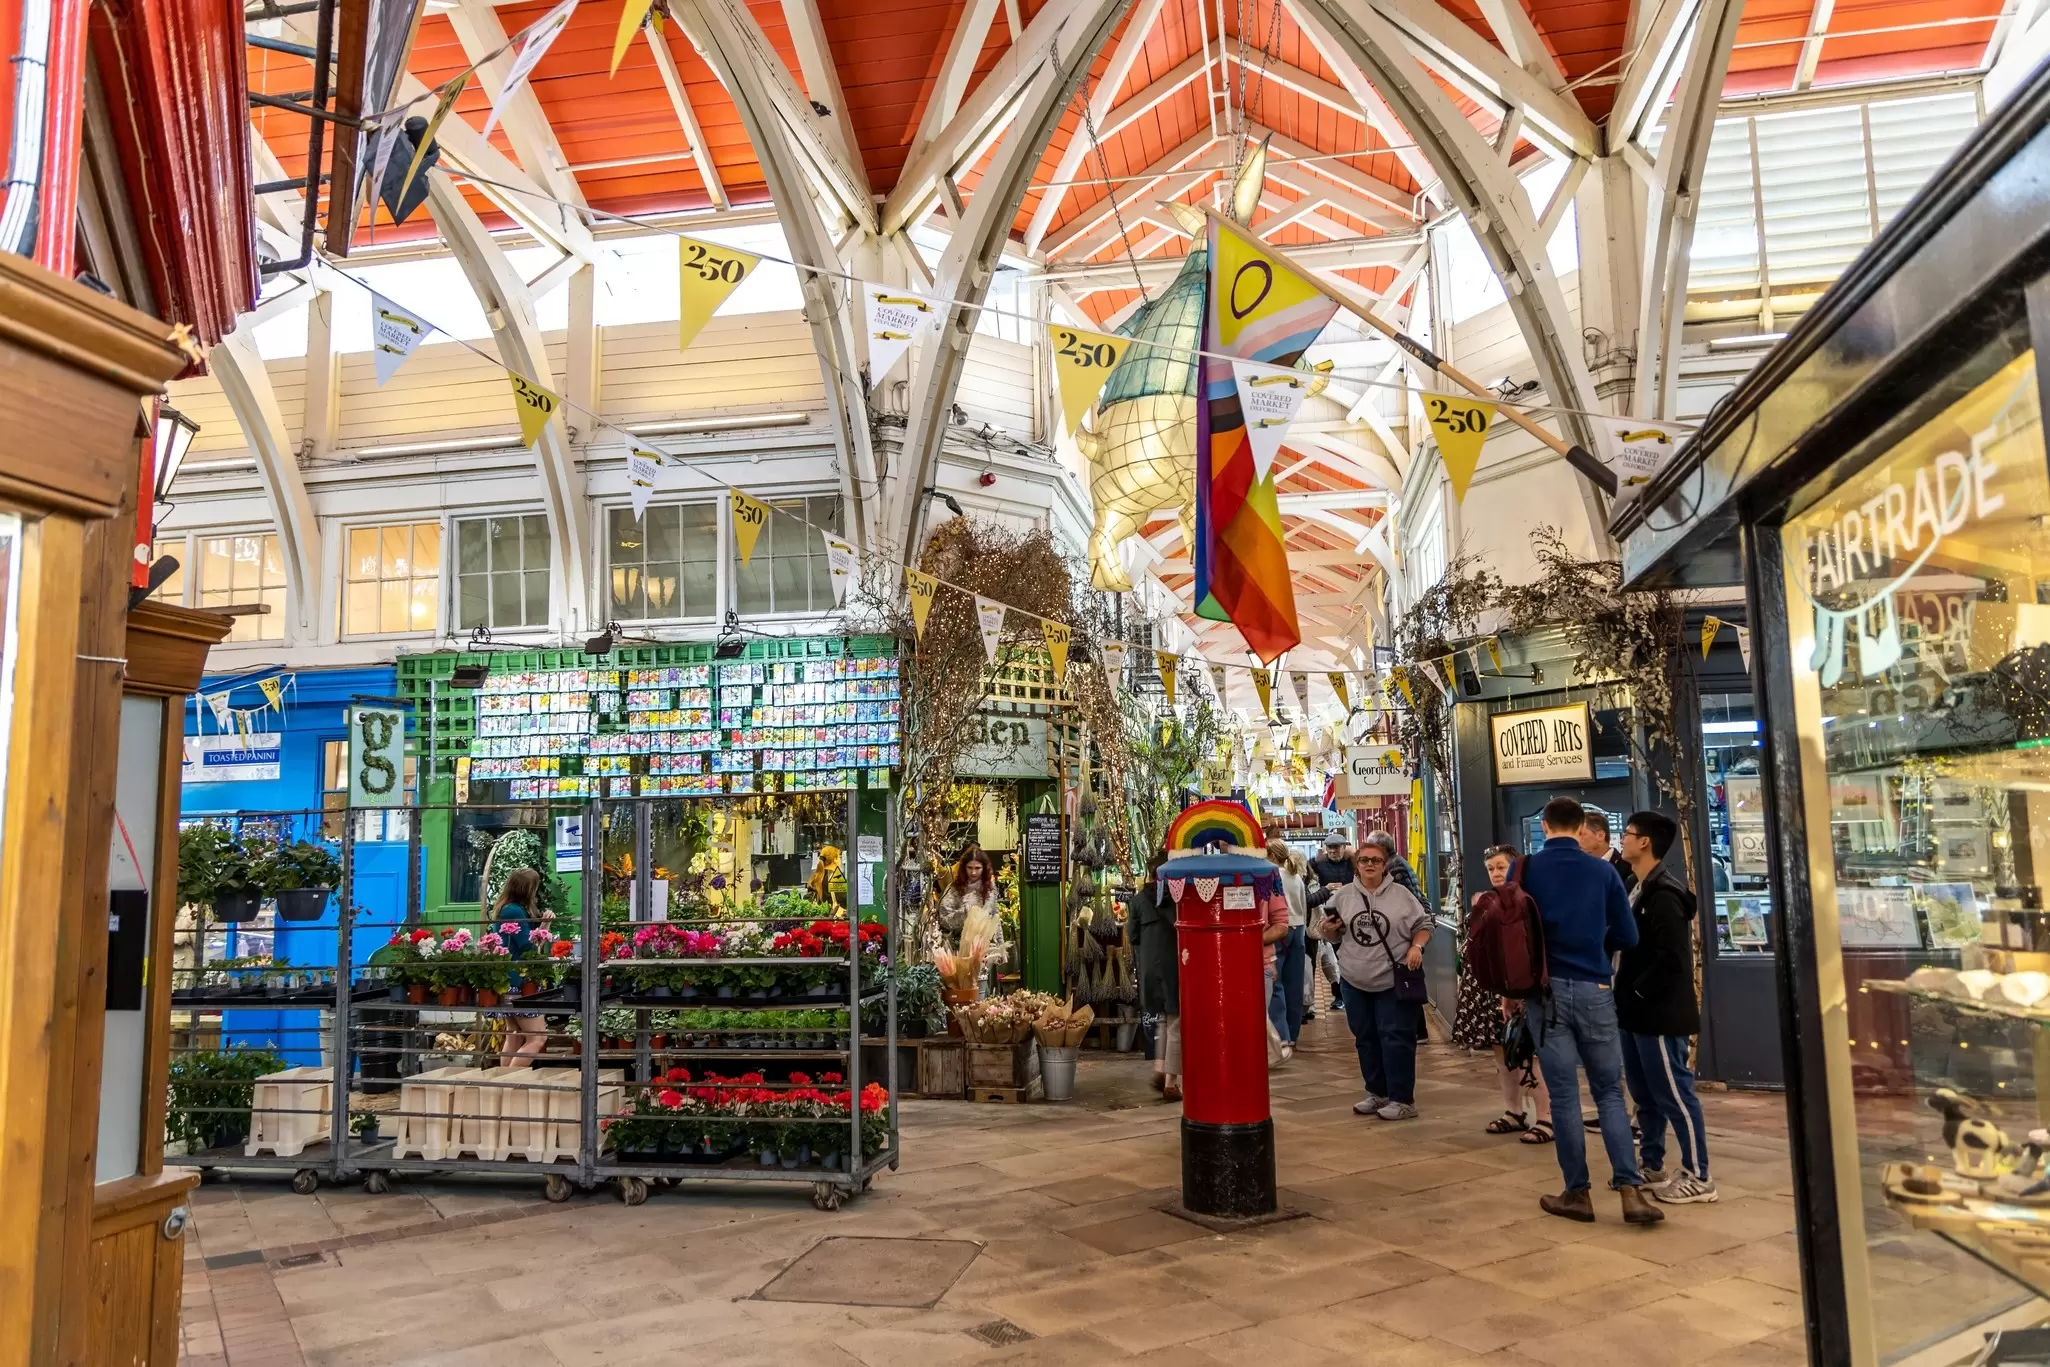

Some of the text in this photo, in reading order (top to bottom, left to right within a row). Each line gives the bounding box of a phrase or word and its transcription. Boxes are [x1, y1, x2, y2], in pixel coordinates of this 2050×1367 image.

[684, 245, 744, 284] 250
[876, 312, 917, 328] MARKET
[877, 307, 918, 322] COVERED
[380, 321, 411, 342] COVERED
[380, 326, 410, 346] MARKET
[1058, 332, 1116, 368] 250
[515, 377, 552, 413] 250
[1251, 391, 1292, 403] COVERED
[1249, 405, 1278, 413] OXFORD
[1250, 398, 1292, 409] MARKET
[1430, 400, 1487, 434] 250
[1623, 447, 1660, 459] COVERED
[1623, 454, 1657, 467] MARKET
[734, 495, 763, 525] 250
[910, 573, 933, 597] 250
[1045, 624, 1068, 644] 250
[1704, 619, 1717, 633] 250
[1159, 655, 1176, 674] 250
[262, 680, 279, 692] 250
[1253, 671, 1270, 687] 250
[1330, 675, 1346, 688] 250
[1500, 719, 1583, 757] COVERED ARTS
[208, 752, 275, 763] TOASTED PANINI
[1502, 755, 1583, 769] and Framing Services
